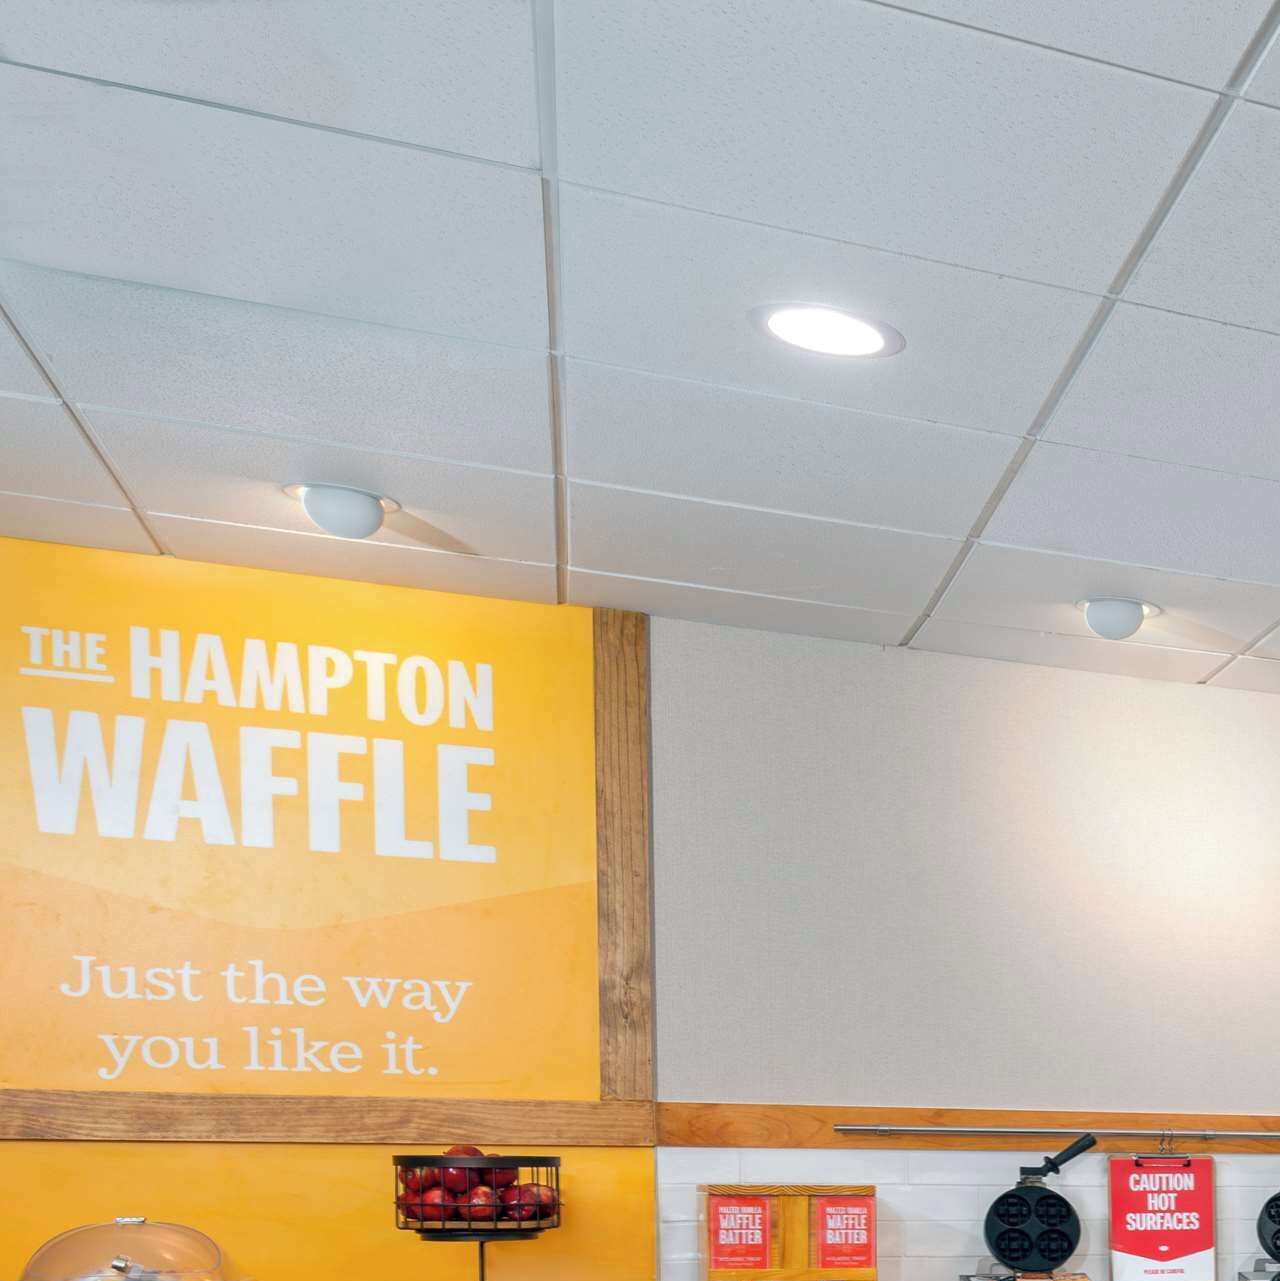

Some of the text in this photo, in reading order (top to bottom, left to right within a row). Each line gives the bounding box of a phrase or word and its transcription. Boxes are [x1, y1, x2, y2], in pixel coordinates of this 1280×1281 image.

[20, 626, 493, 731] THE HAMPTON
[21, 706, 497, 862] WAFFLE
[60, 955, 472, 1023] Just the way
[97, 1026, 439, 1080] you like it.
[1129, 1173, 1195, 1191] CAUTION
[1147, 1193, 1177, 1211] HOT
[719, 1214, 762, 1229] WAFFLE
[825, 1214, 867, 1229] WAFFLE
[1126, 1212, 1200, 1231] SURFACES
[719, 1230, 762, 1245] BATTER
[825, 1230, 867, 1245] BATTER
